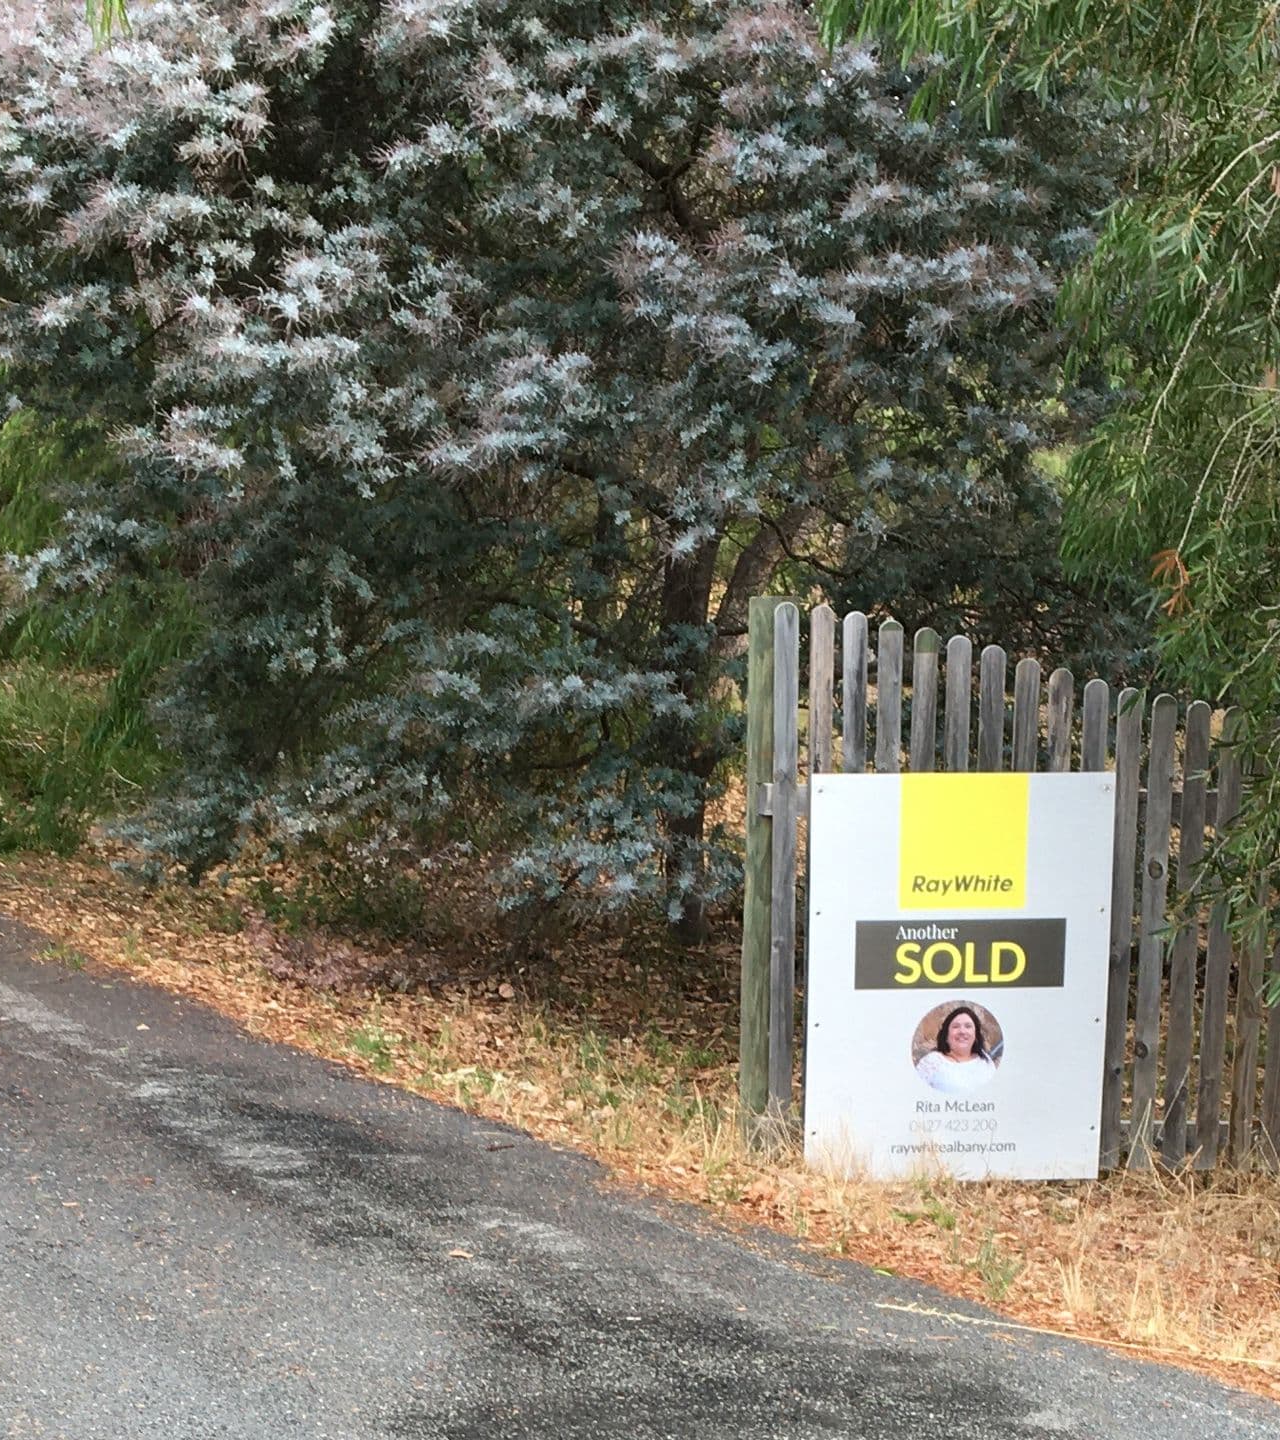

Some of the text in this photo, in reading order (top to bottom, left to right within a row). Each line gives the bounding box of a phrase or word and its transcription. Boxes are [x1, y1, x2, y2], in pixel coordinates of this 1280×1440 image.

[911, 874, 1014, 896] RayWhite
[895, 923, 959, 940] Another
[894, 942, 1027, 984] SOLD
[915, 1100, 996, 1112] Rita McLean
[944, 1118, 969, 1131] 423
[890, 1141, 1017, 1155] raywhitealbany.com
